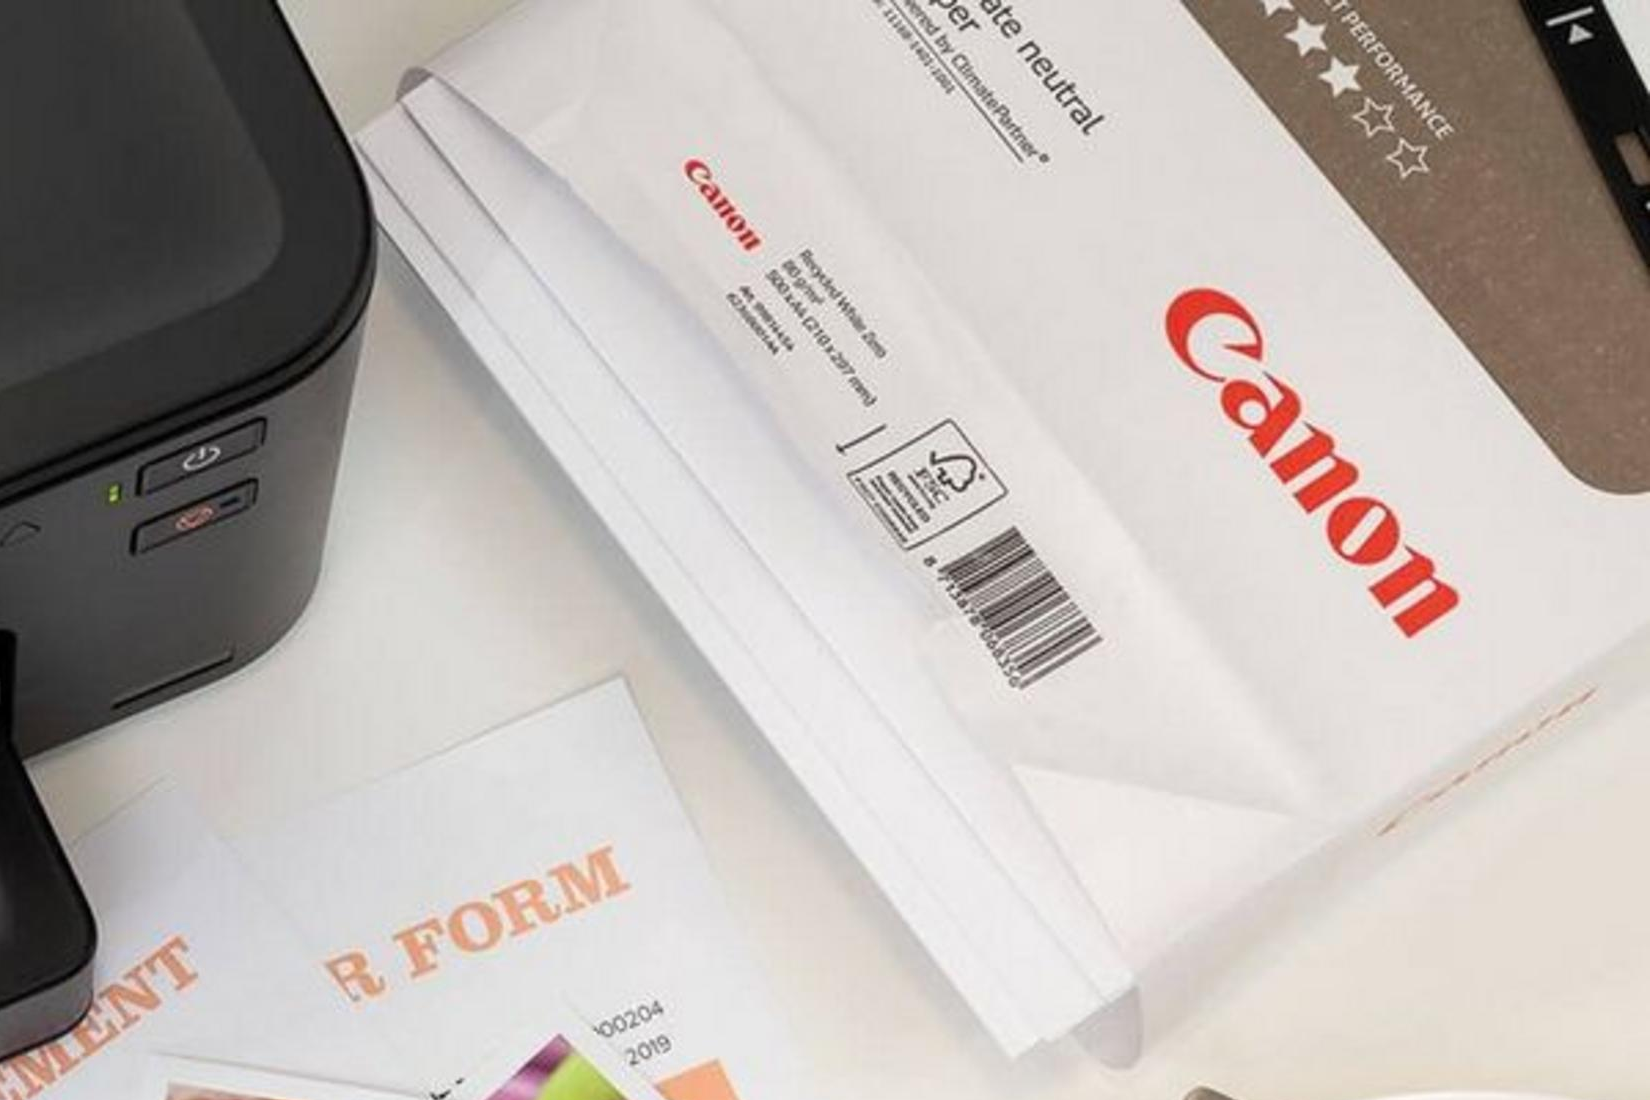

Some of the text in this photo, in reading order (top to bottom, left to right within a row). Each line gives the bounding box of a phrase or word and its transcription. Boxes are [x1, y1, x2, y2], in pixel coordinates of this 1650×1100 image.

[935, 34, 954, 54] by
[1016, 40, 1105, 136] neutral
[1341, 10, 1454, 141] PERFORMANCE
[684, 159, 762, 252] Canon
[1165, 288, 1460, 639] Canon
[392, 846, 631, 979] FORM
[594, 1000, 665, 1038] 00204
[625, 1034, 672, 1067] 2019
